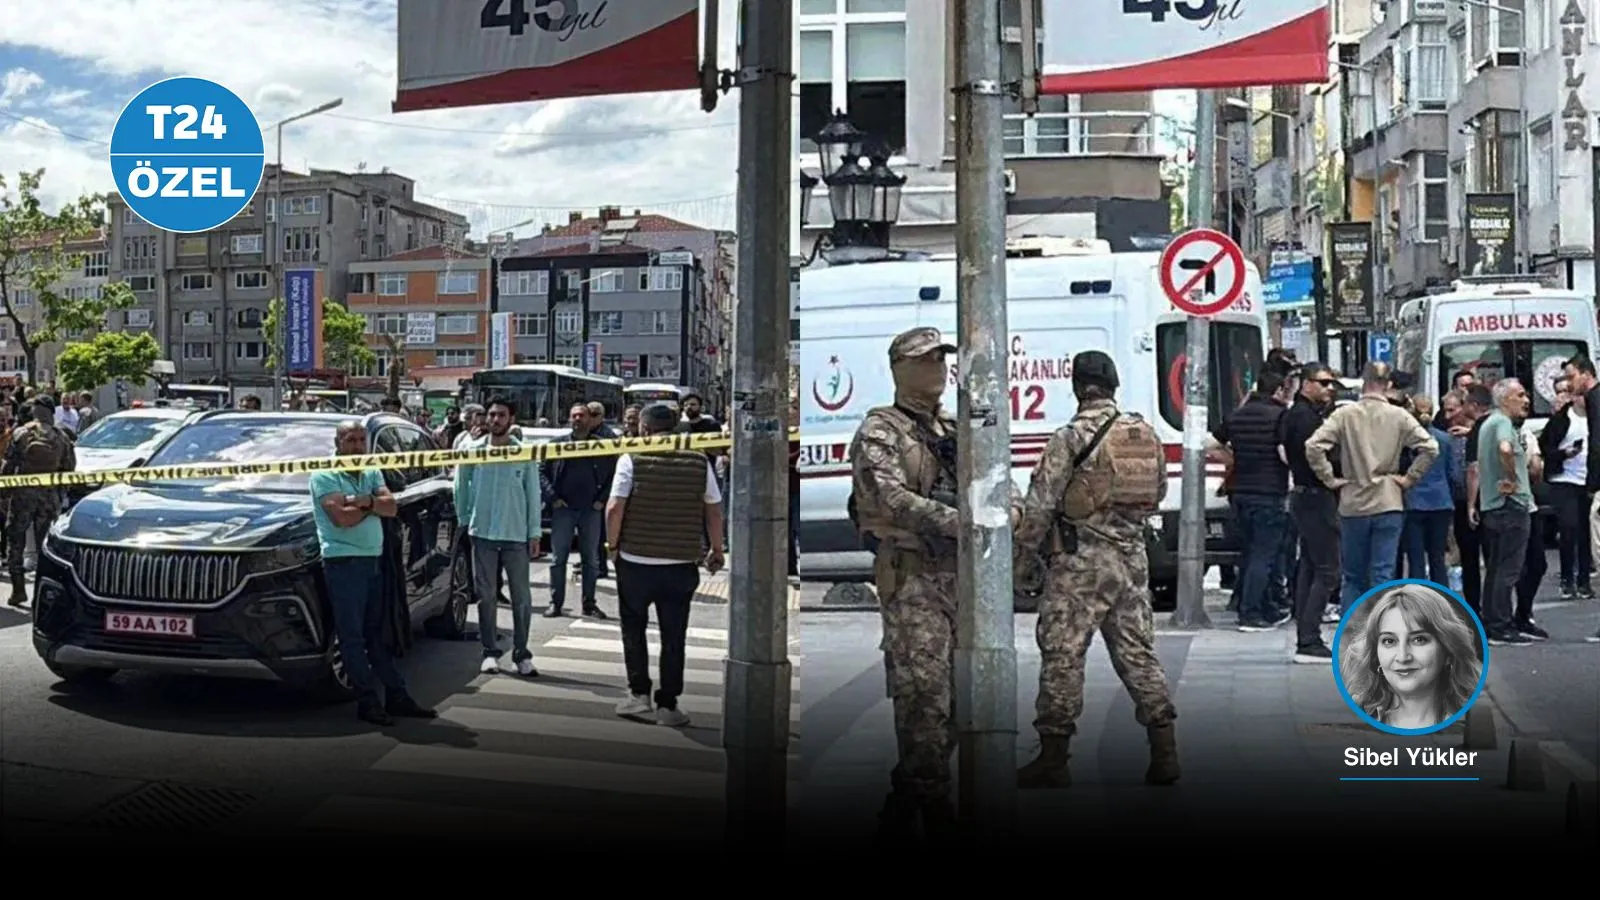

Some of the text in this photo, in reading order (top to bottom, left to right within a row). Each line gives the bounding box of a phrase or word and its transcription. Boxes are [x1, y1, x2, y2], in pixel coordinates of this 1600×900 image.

[1455, 312, 1568, 333] AMBULANS
[112, 615, 188, 633] 59 AA 102
